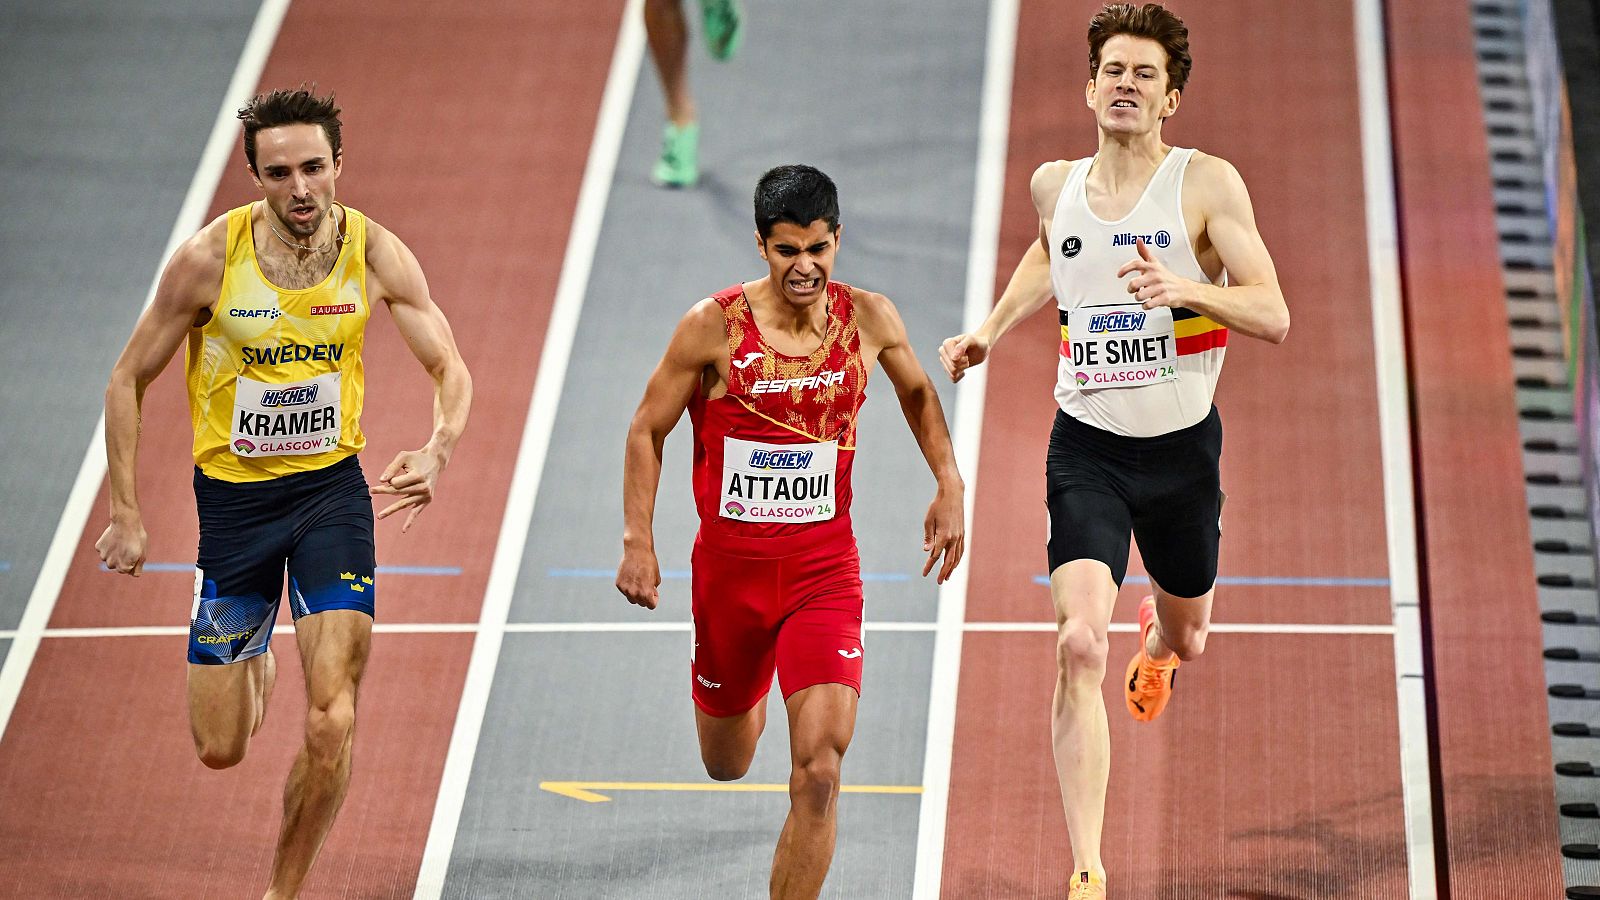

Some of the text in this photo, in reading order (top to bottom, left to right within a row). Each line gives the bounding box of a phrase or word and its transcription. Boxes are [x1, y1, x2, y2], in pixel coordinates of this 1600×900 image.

[229, 308, 271, 318] CRAFT
[311, 304, 355, 314] BAUHAUS
[1088, 312, 1146, 333] HI-CHEW
[241, 343, 344, 366] SWEDEN
[1073, 335, 1169, 366] DE SMET
[750, 370, 846, 394] ESPAÑA
[1094, 366, 1174, 383] GLASGOW 24
[261, 384, 319, 407] HI-CHEW
[238, 406, 335, 436] KRAMER
[260, 436, 337, 452] GLASGOW 24
[749, 448, 813, 469] HI-CHEW
[728, 472, 829, 501] ATTAOUI
[750, 504, 831, 517] GLASGOW 24
[197, 632, 243, 644] CRAFT
[697, 674, 721, 689] ESP
